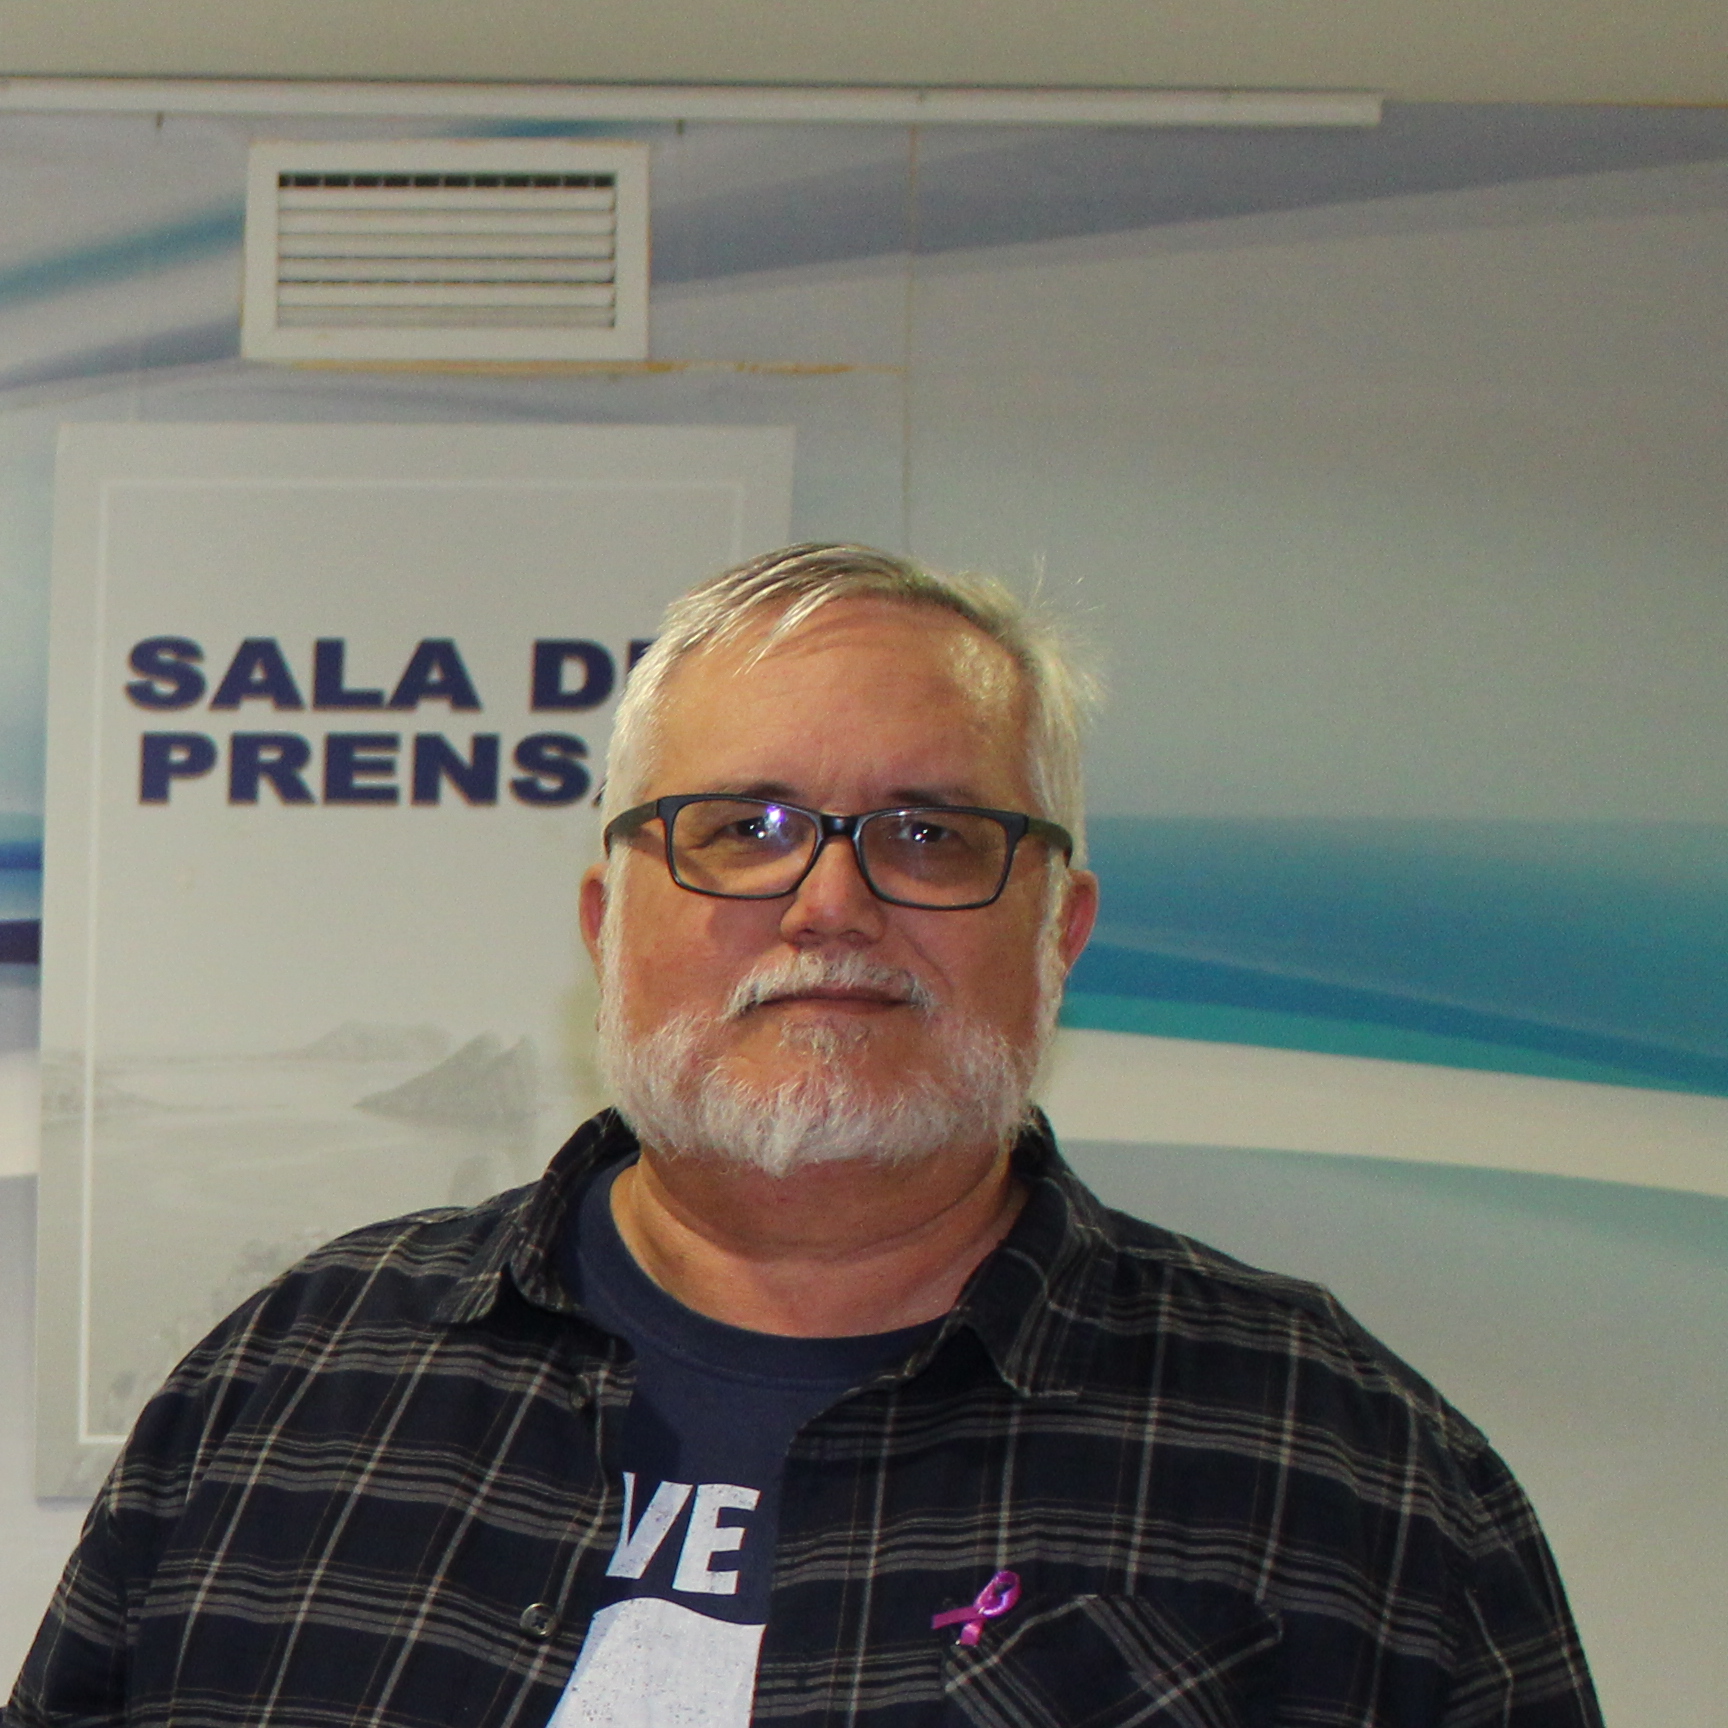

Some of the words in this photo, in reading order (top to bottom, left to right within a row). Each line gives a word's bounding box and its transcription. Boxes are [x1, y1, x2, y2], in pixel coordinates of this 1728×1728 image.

[124, 636, 482, 712] SALA
[531, 638, 656, 712] D
[138, 731, 606, 807] PRENS
